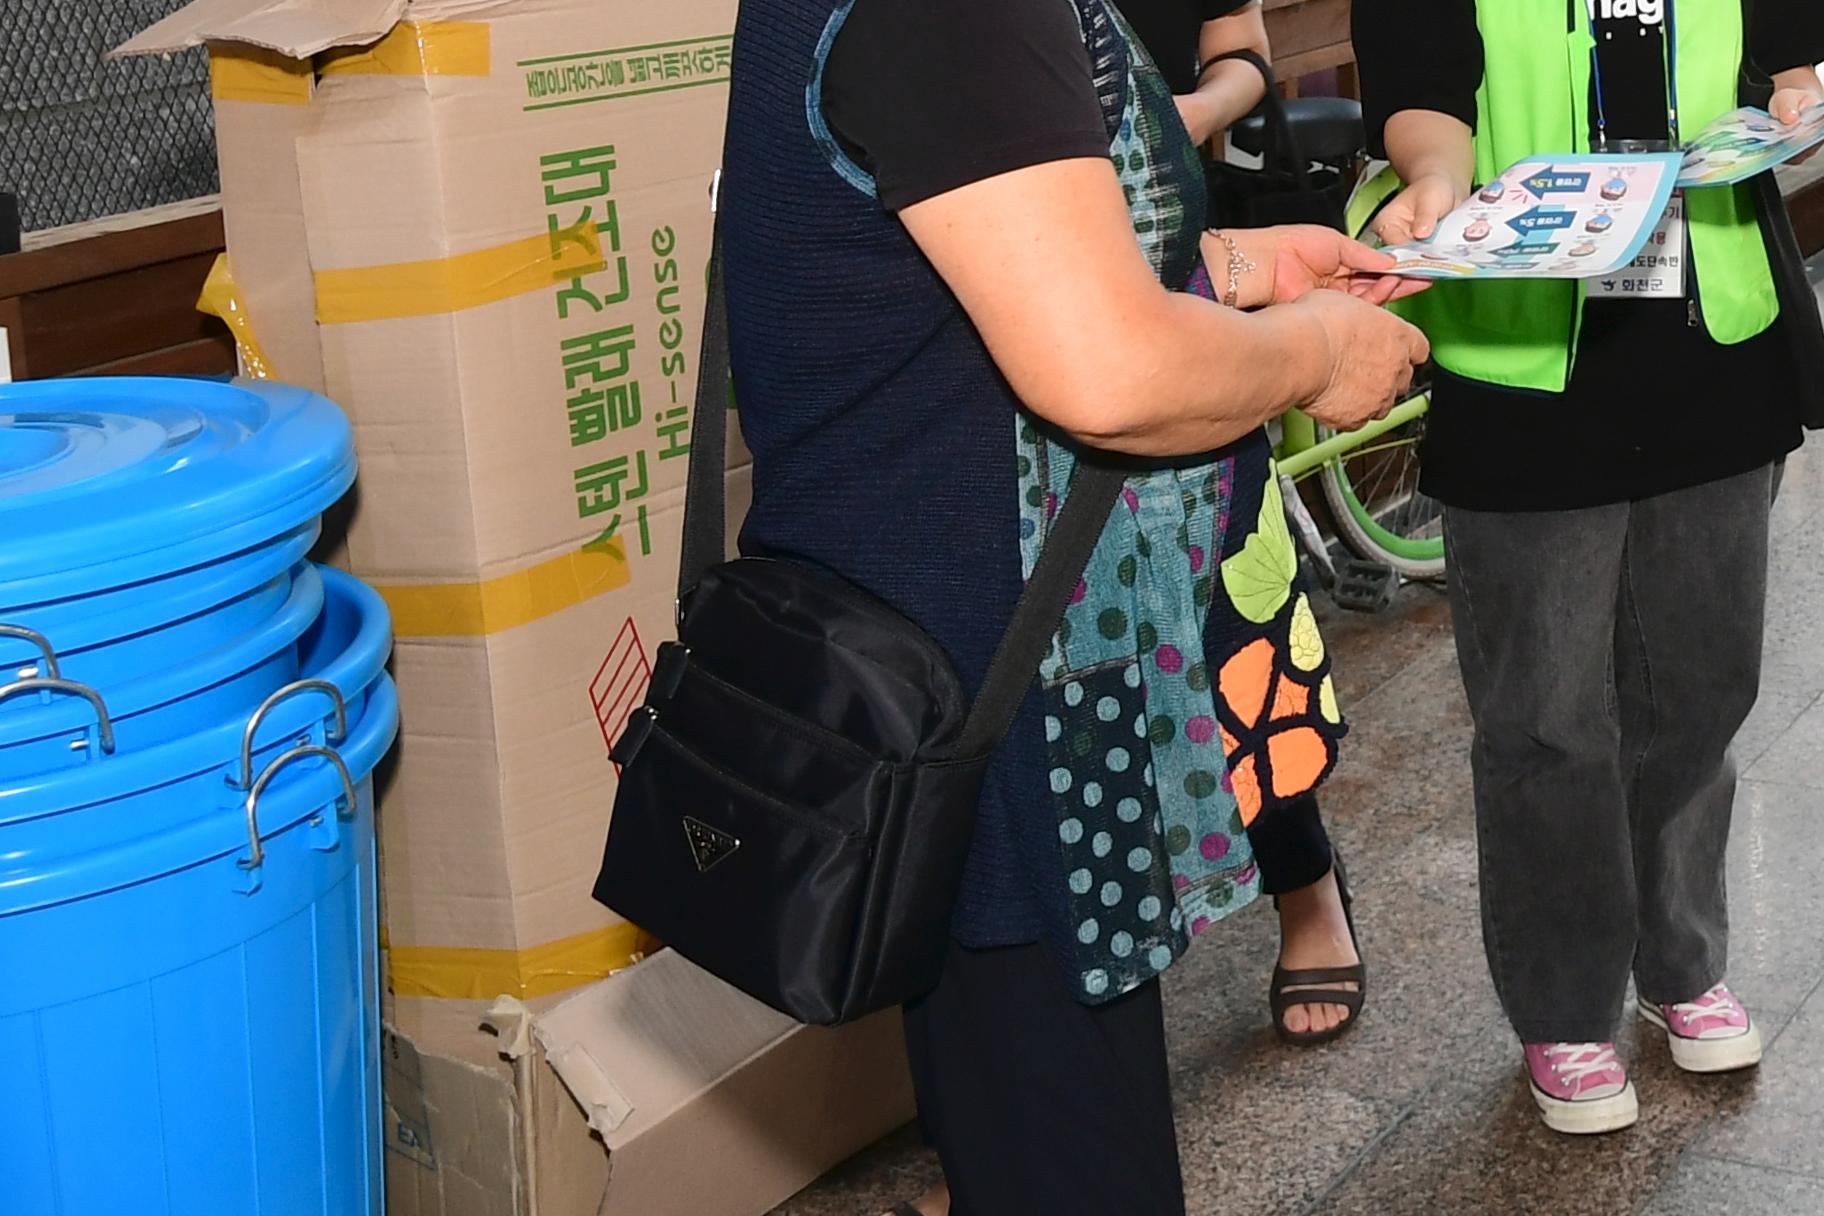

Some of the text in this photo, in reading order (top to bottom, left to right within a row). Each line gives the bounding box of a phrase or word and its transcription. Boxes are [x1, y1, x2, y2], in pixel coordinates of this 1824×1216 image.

[540, 145, 651, 563] 스텐 빨래 건조대
[651, 225, 690, 462] Hi-sense
[1621, 278, 1663, 292] 화천군
